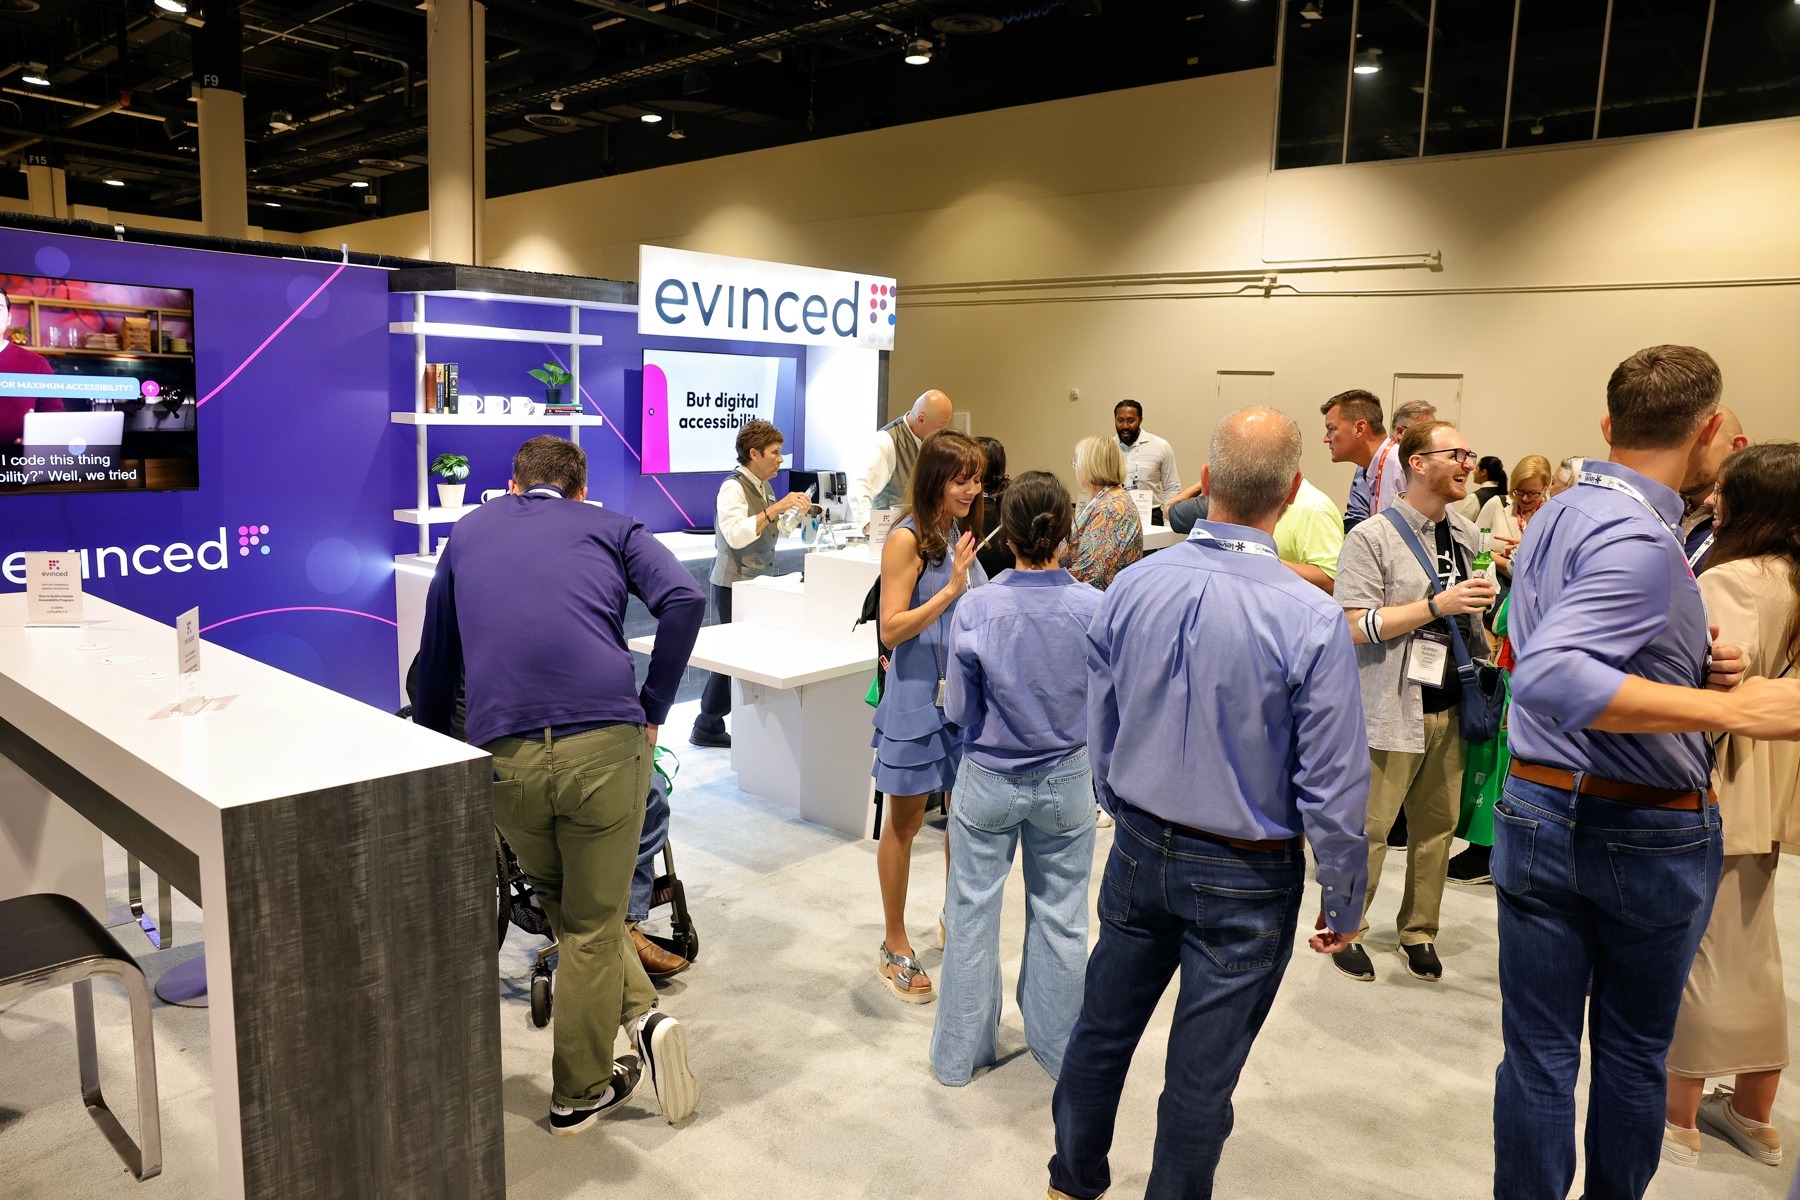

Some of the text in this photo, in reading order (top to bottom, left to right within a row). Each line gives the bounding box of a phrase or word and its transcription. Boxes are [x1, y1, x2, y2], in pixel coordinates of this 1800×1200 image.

[203, 74, 219, 87] F9
[29, 155, 47, 165] F15
[655, 278, 860, 338] evinced
[0, 380, 134, 392] OR MAXIMUM ACCESSIBILITY?
[686, 391, 759, 412] But digital
[1, 453, 111, 467] I code this thing
[47, 470, 82, 483] Well,
[85, 471, 105, 481] we
[108, 469, 137, 480] tried
[1, 526, 229, 585] einced
